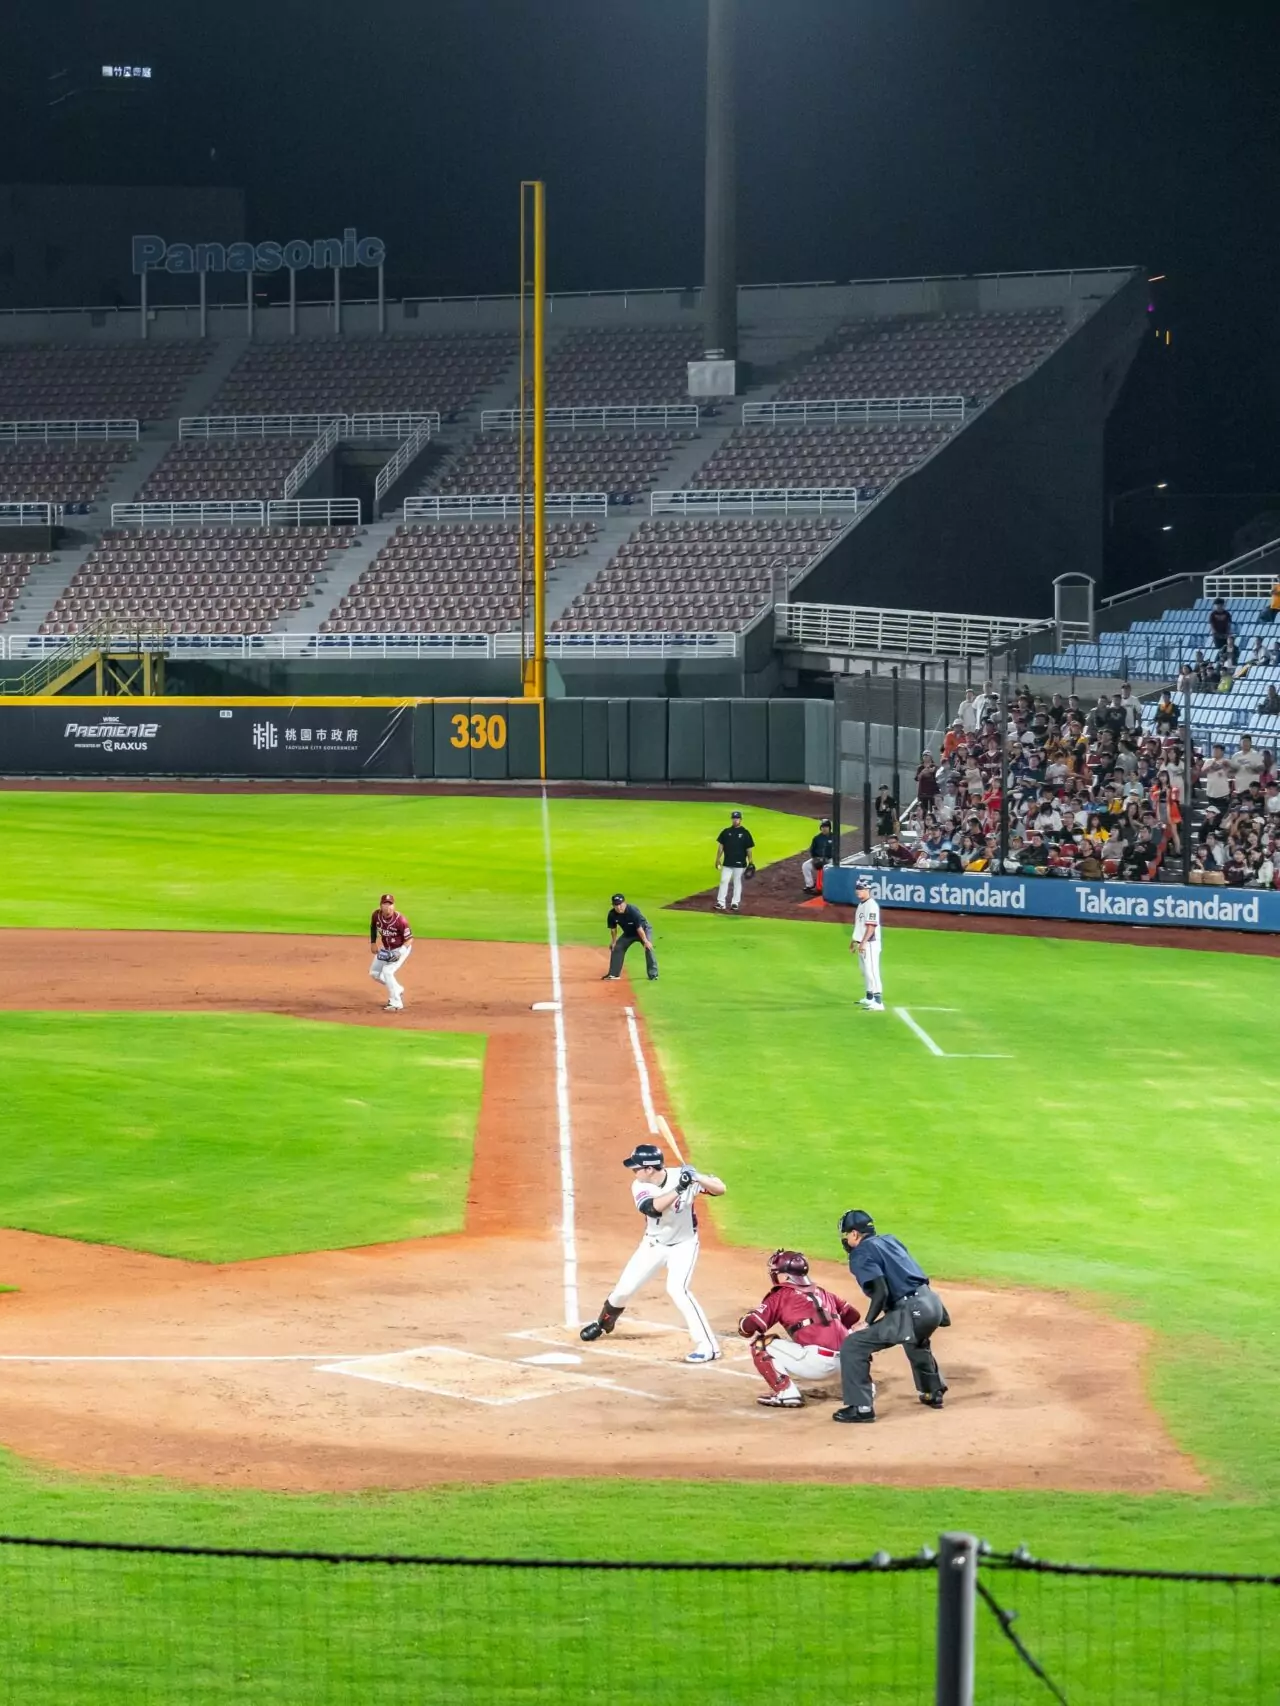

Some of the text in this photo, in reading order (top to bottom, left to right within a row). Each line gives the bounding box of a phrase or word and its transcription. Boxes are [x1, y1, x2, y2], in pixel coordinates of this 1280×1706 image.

[132, 228, 386, 275] Panasonic
[114, 742, 148, 751] RAXUS
[285, 728, 359, 742] 桃園市政府
[450, 714, 507, 750] 330
[929, 882, 1026, 909] standard
[1075, 887, 1260, 923] Takara standard
